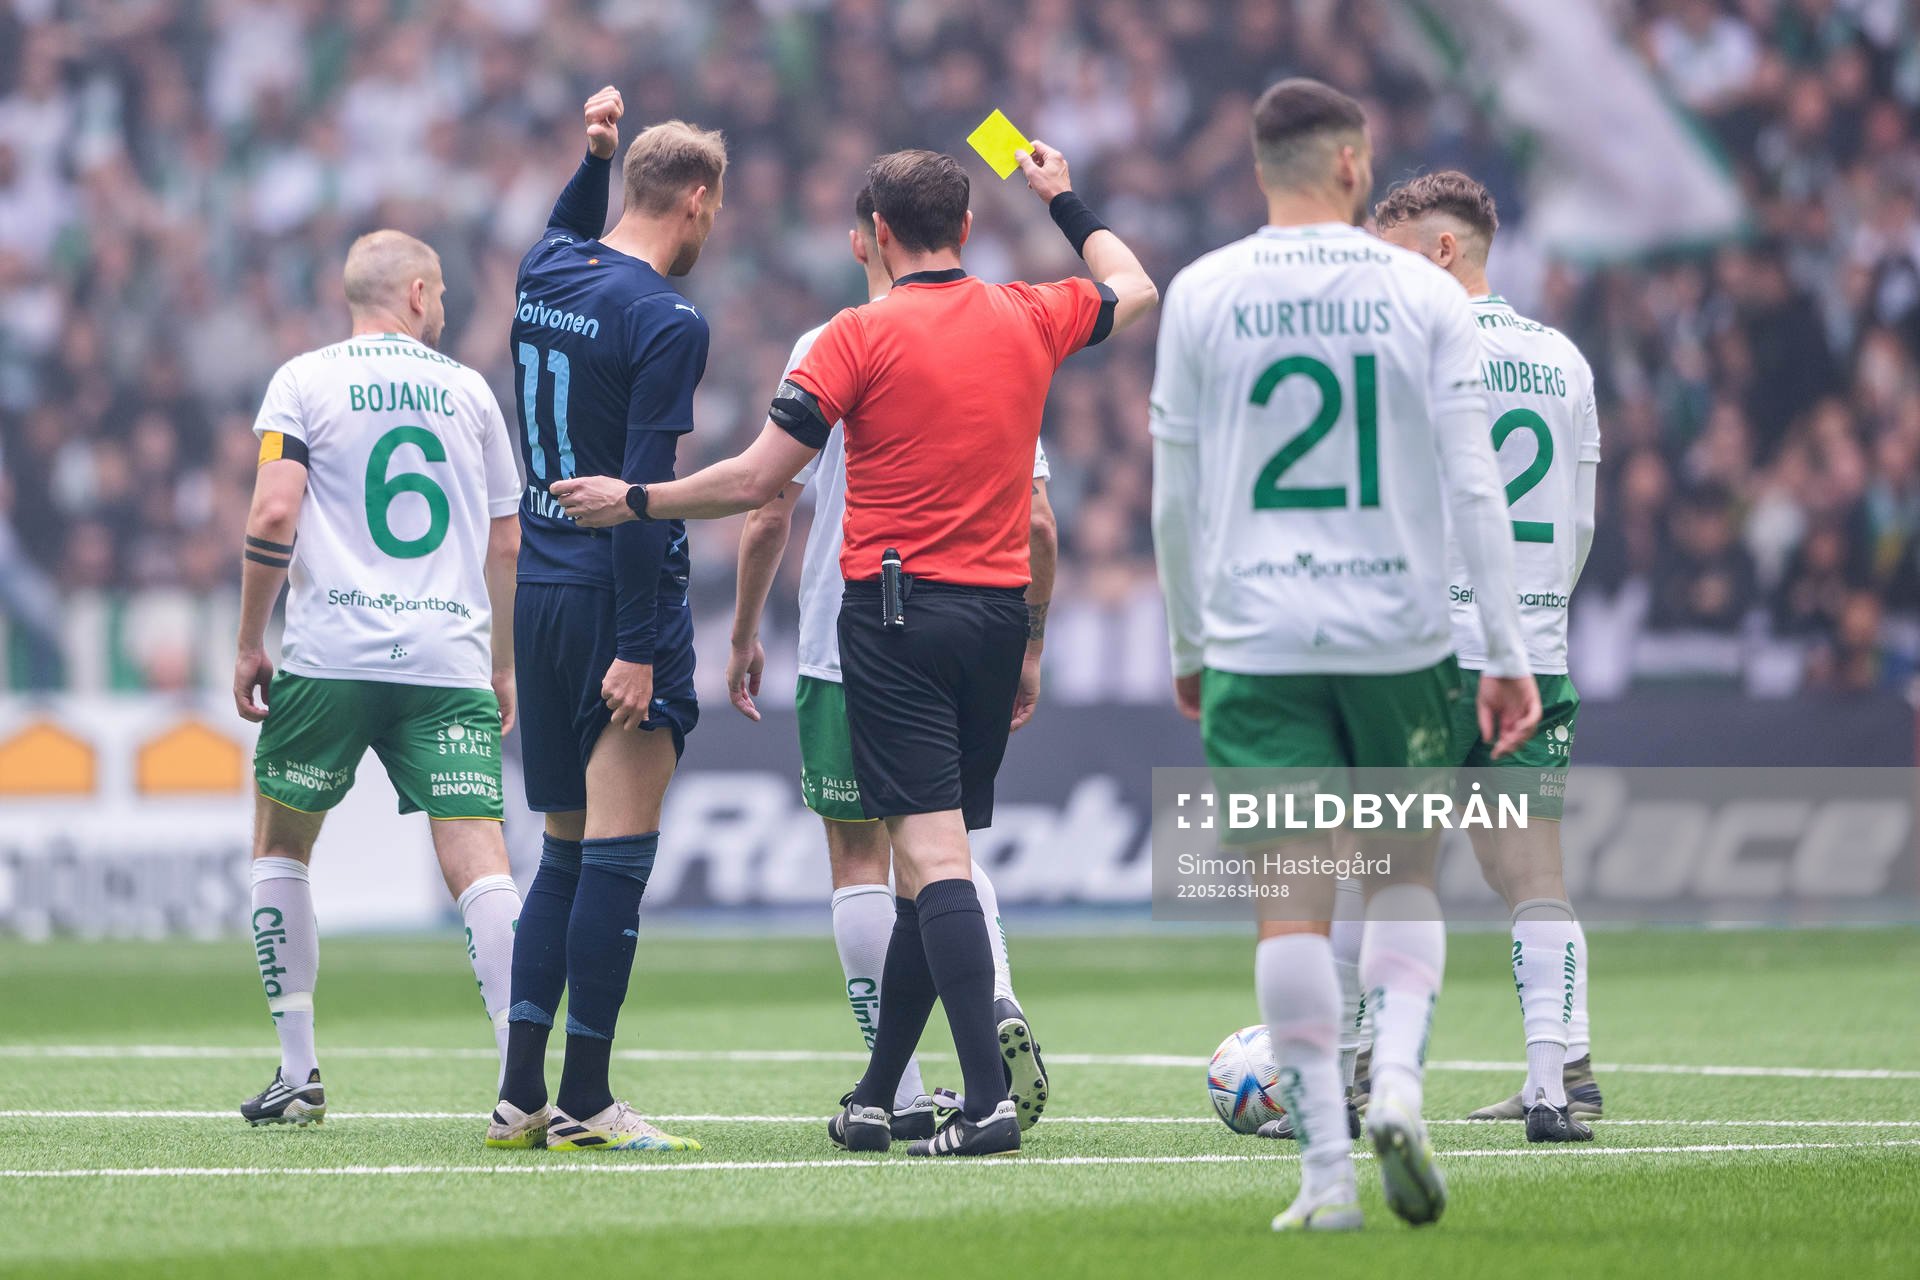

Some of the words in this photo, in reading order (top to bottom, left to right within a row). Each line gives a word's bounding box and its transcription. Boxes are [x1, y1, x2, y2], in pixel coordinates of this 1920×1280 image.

[515, 291, 600, 339] Toivonen
[1233, 297, 1391, 339] KURTULUS
[1480, 360, 1567, 397] ANDBERG
[349, 381, 455, 416] BOJANIC
[519, 341, 576, 480] 11
[1248, 354, 1380, 511] 21
[364, 425, 450, 559] 6
[328, 589, 383, 610] Sefina
[394, 597, 472, 619] pantbank
[439, 740, 492, 758] STRÅLE
[285, 769, 333, 791] RENOVA
[432, 782, 487, 797] RENOVA
